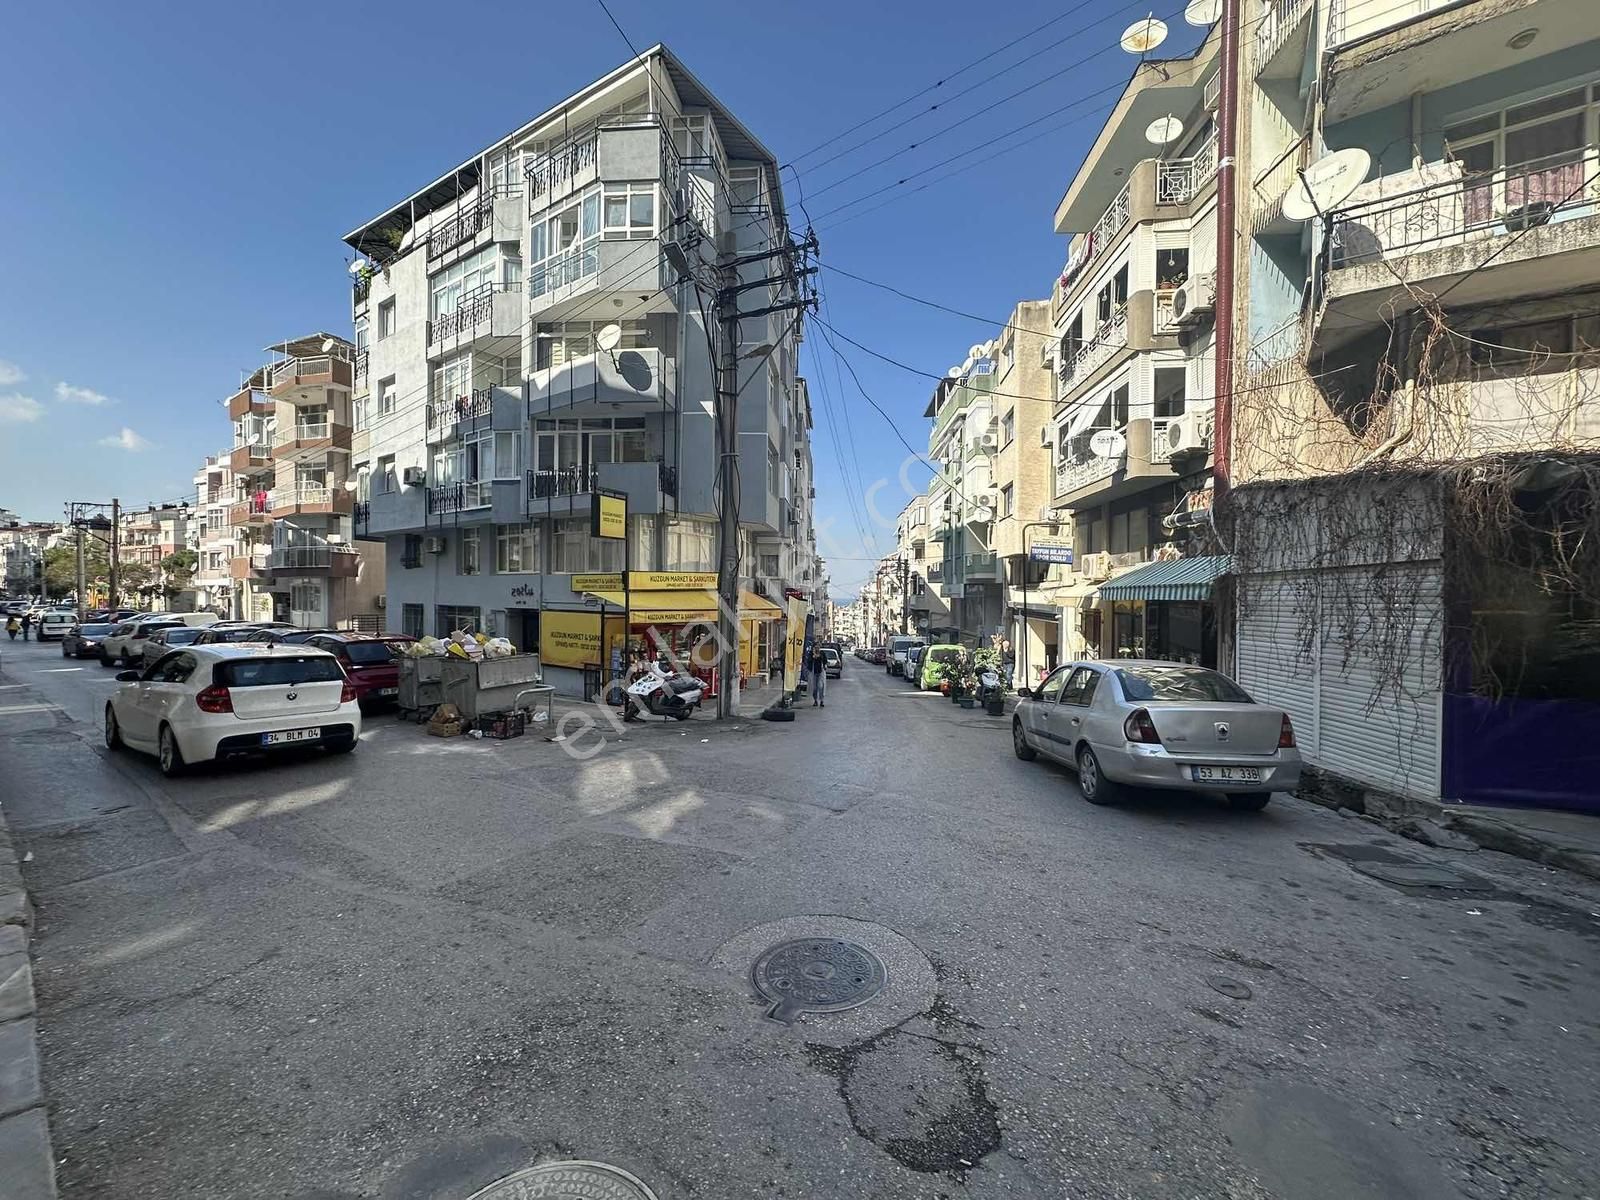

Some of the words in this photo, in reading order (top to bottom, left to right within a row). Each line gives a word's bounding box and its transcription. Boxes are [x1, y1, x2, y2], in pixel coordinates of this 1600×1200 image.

[670, 575, 688, 583] MARKET
[268, 734, 279, 743] 34
[286, 732, 303, 740] BLM
[308, 729, 319, 738] 04
[1200, 767, 1213, 778] 53
[1221, 768, 1233, 779] AZ
[1240, 768, 1258, 780] 338
